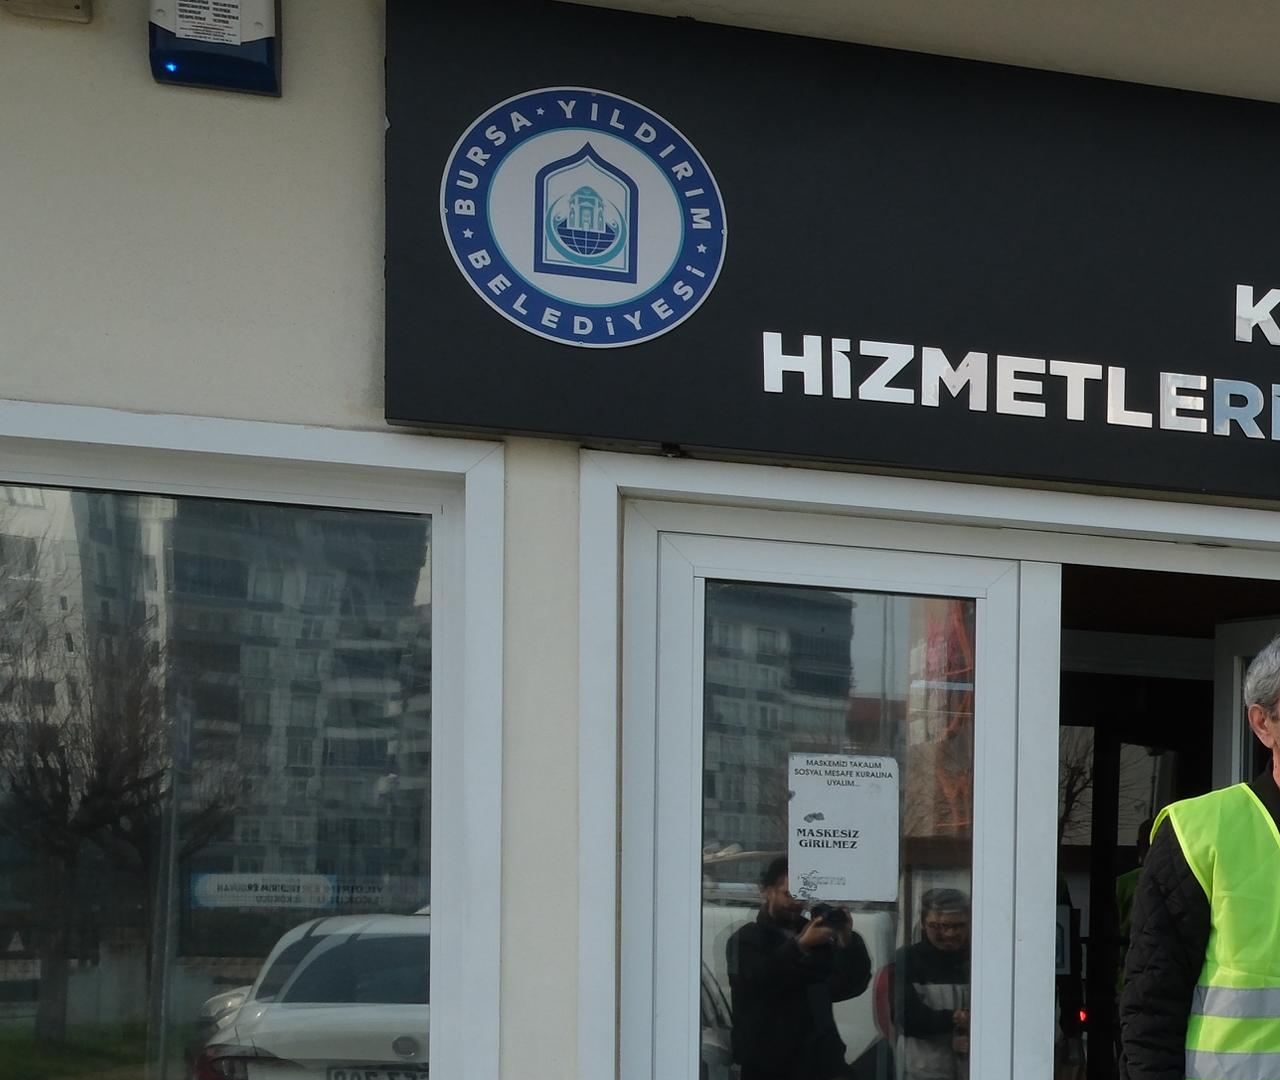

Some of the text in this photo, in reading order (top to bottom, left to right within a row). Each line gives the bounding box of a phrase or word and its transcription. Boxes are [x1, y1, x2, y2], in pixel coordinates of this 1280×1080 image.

[454, 99, 712, 230] BURSA YILDIRIM
[467, 249, 706, 336] BELEDİYESİ
[794, 768, 823, 777] SOSYAL
[825, 769, 853, 778] MESAFE
[796, 828, 860, 839] MASKESİZ
[799, 838, 858, 849] GİRİLMEZ
